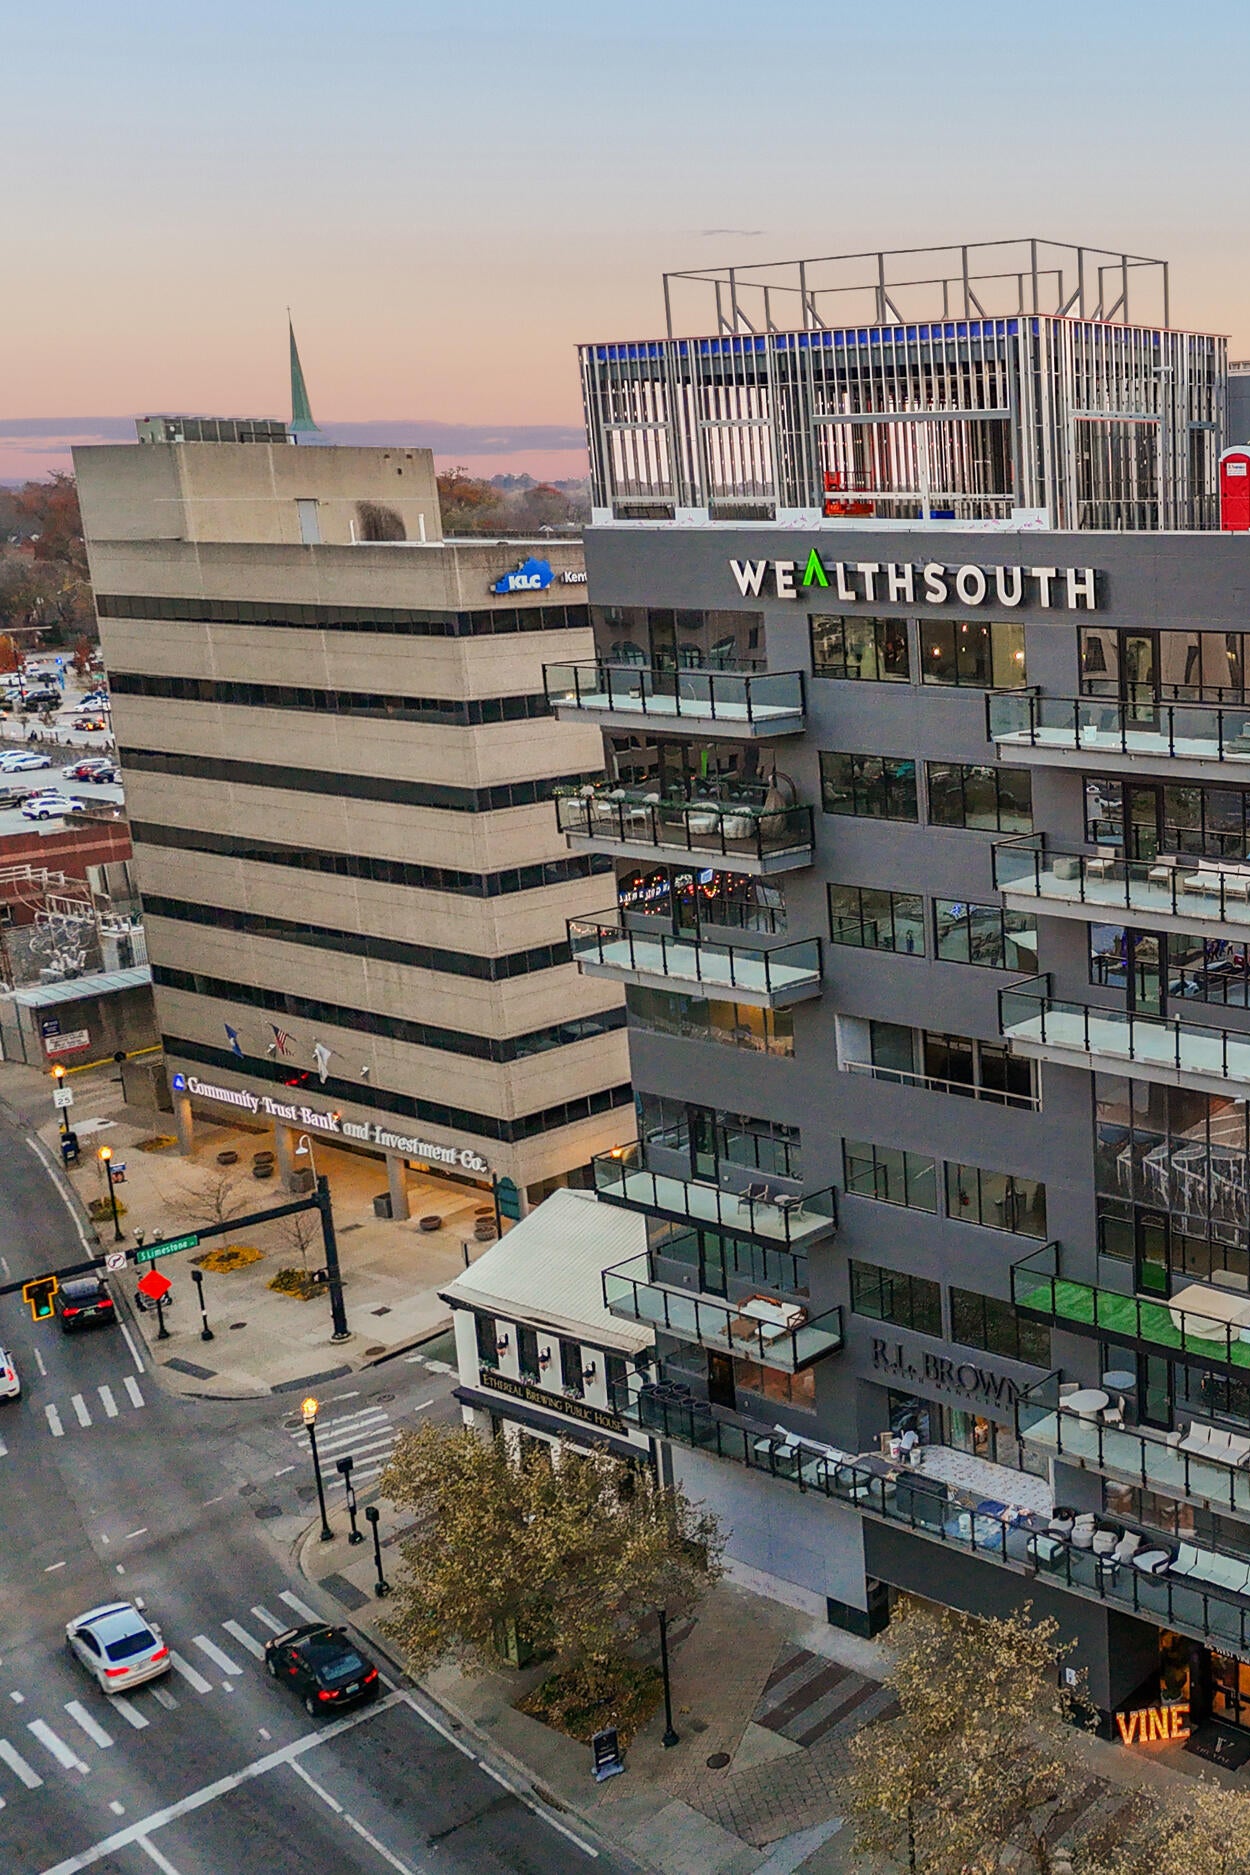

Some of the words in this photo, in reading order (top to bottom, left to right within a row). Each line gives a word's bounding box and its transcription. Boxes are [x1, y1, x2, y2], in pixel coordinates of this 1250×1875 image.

[508, 574, 541, 590] KLC
[729, 547, 1097, 609] WEALTHSOUTH
[57, 1096, 71, 1105] 25
[187, 1076, 260, 1114] Community
[261, 1096, 298, 1121] Trust
[300, 1107, 340, 1132] Bank
[342, 1121, 370, 1140] and
[374, 1126, 457, 1165] Investment
[460, 1150, 488, 1172] Co.
[141, 1252, 147, 1261] S
[147, 1240, 188, 1259] Limestone
[922, 1350, 1031, 1406] BROWN
[482, 1374, 524, 1398] ETHEREAL
[525, 1387, 563, 1411] BREWING
[565, 1401, 592, 1422] PUBLIC
[594, 1412, 624, 1433] HOUSE
[1115, 1703, 1191, 1745] VINE
